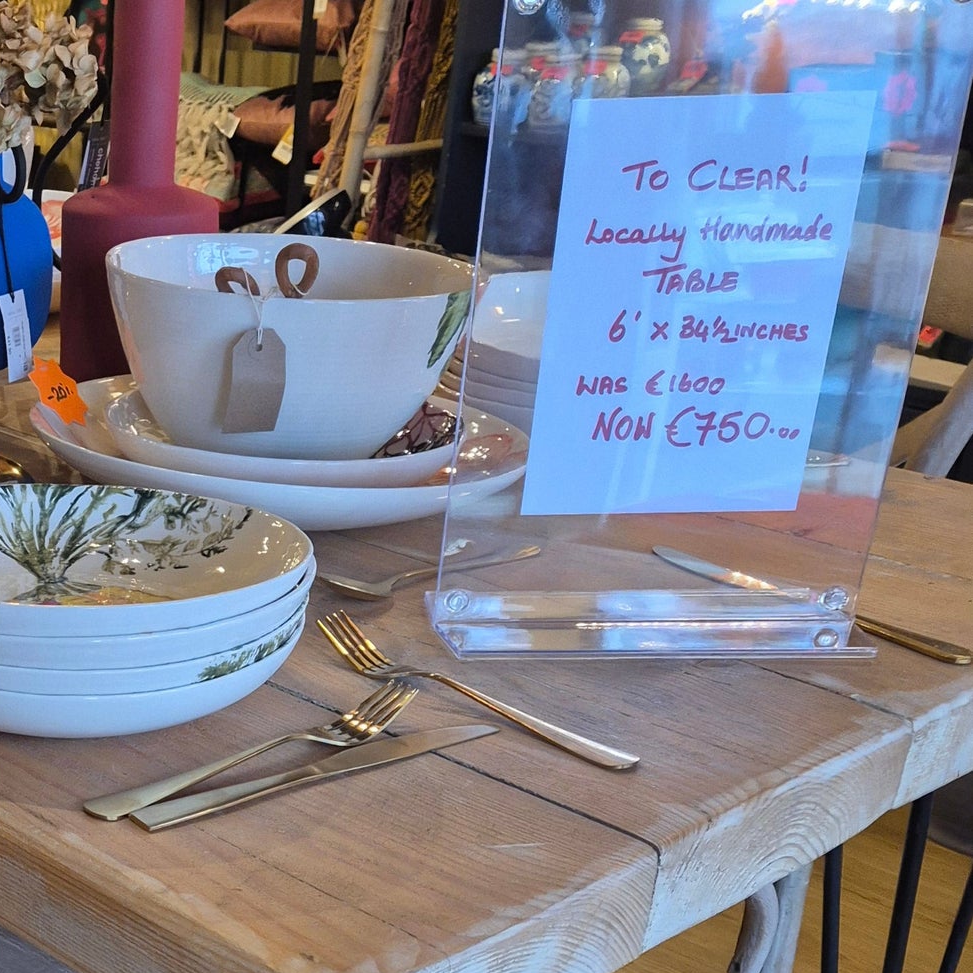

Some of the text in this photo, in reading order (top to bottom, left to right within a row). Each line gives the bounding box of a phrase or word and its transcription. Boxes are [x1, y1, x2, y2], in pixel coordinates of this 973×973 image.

[687, 155, 809, 192] CLEAR!
[585, 213, 833, 262] Locally Handmade
[642, 264, 740, 294] TABLE
[576, 374, 628, 396] WAS
[591, 406, 656, 442] NOW
